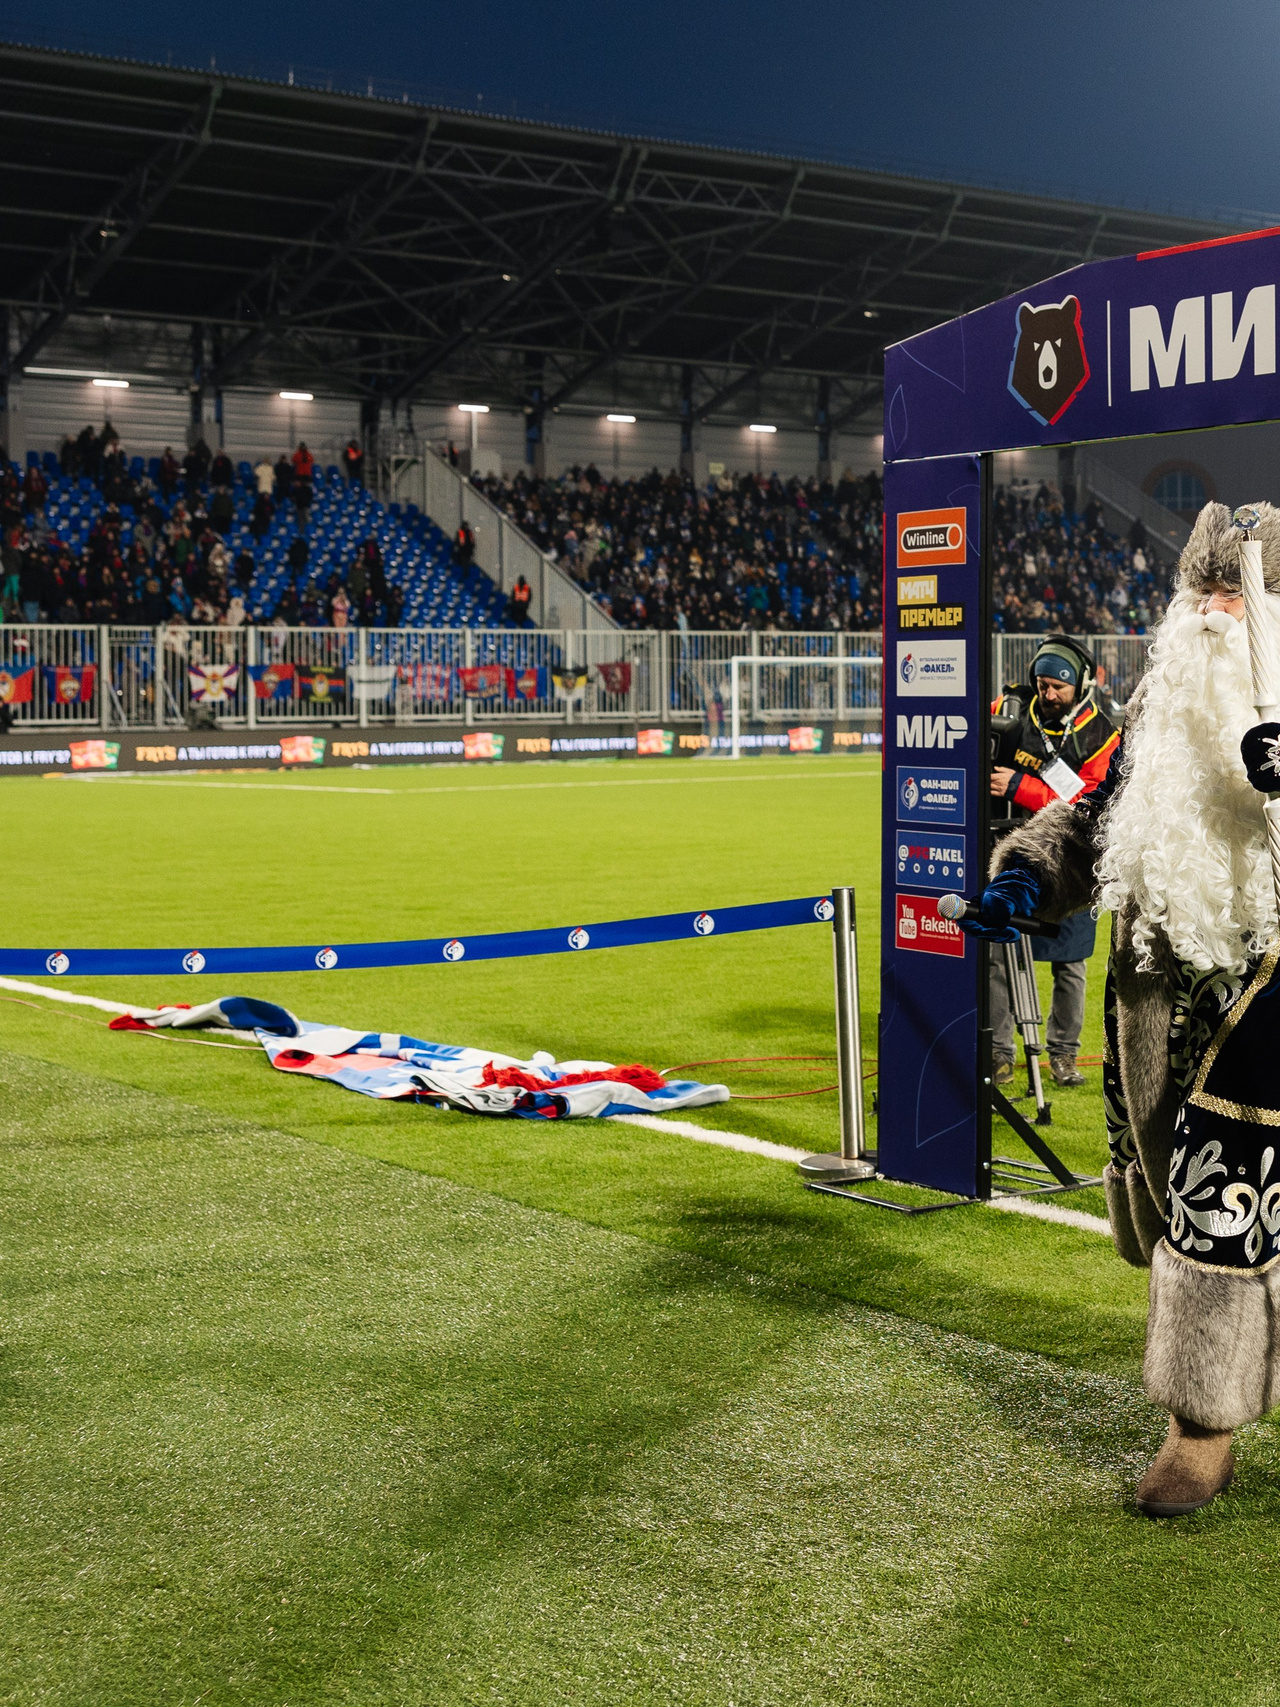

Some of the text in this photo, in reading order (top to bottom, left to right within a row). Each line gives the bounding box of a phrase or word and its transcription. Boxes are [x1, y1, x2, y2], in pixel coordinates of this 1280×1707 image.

[906, 531, 945, 547] Winline
[900, 579, 935, 600] МАТЧ
[900, 607, 963, 628] ПРЕМЬЕР
[920, 664, 955, 673] «ФАКЕЛ»
[896, 715, 969, 749] МИР
[920, 778, 959, 790] ФАН-ШОП
[922, 793, 958, 804] «ФАКЕЛ»
[898, 844, 964, 863] @PFCFAKEL
[901, 904, 915, 919] You
[901, 921, 916, 936] Tube
[920, 915, 961, 936] fakeltv
